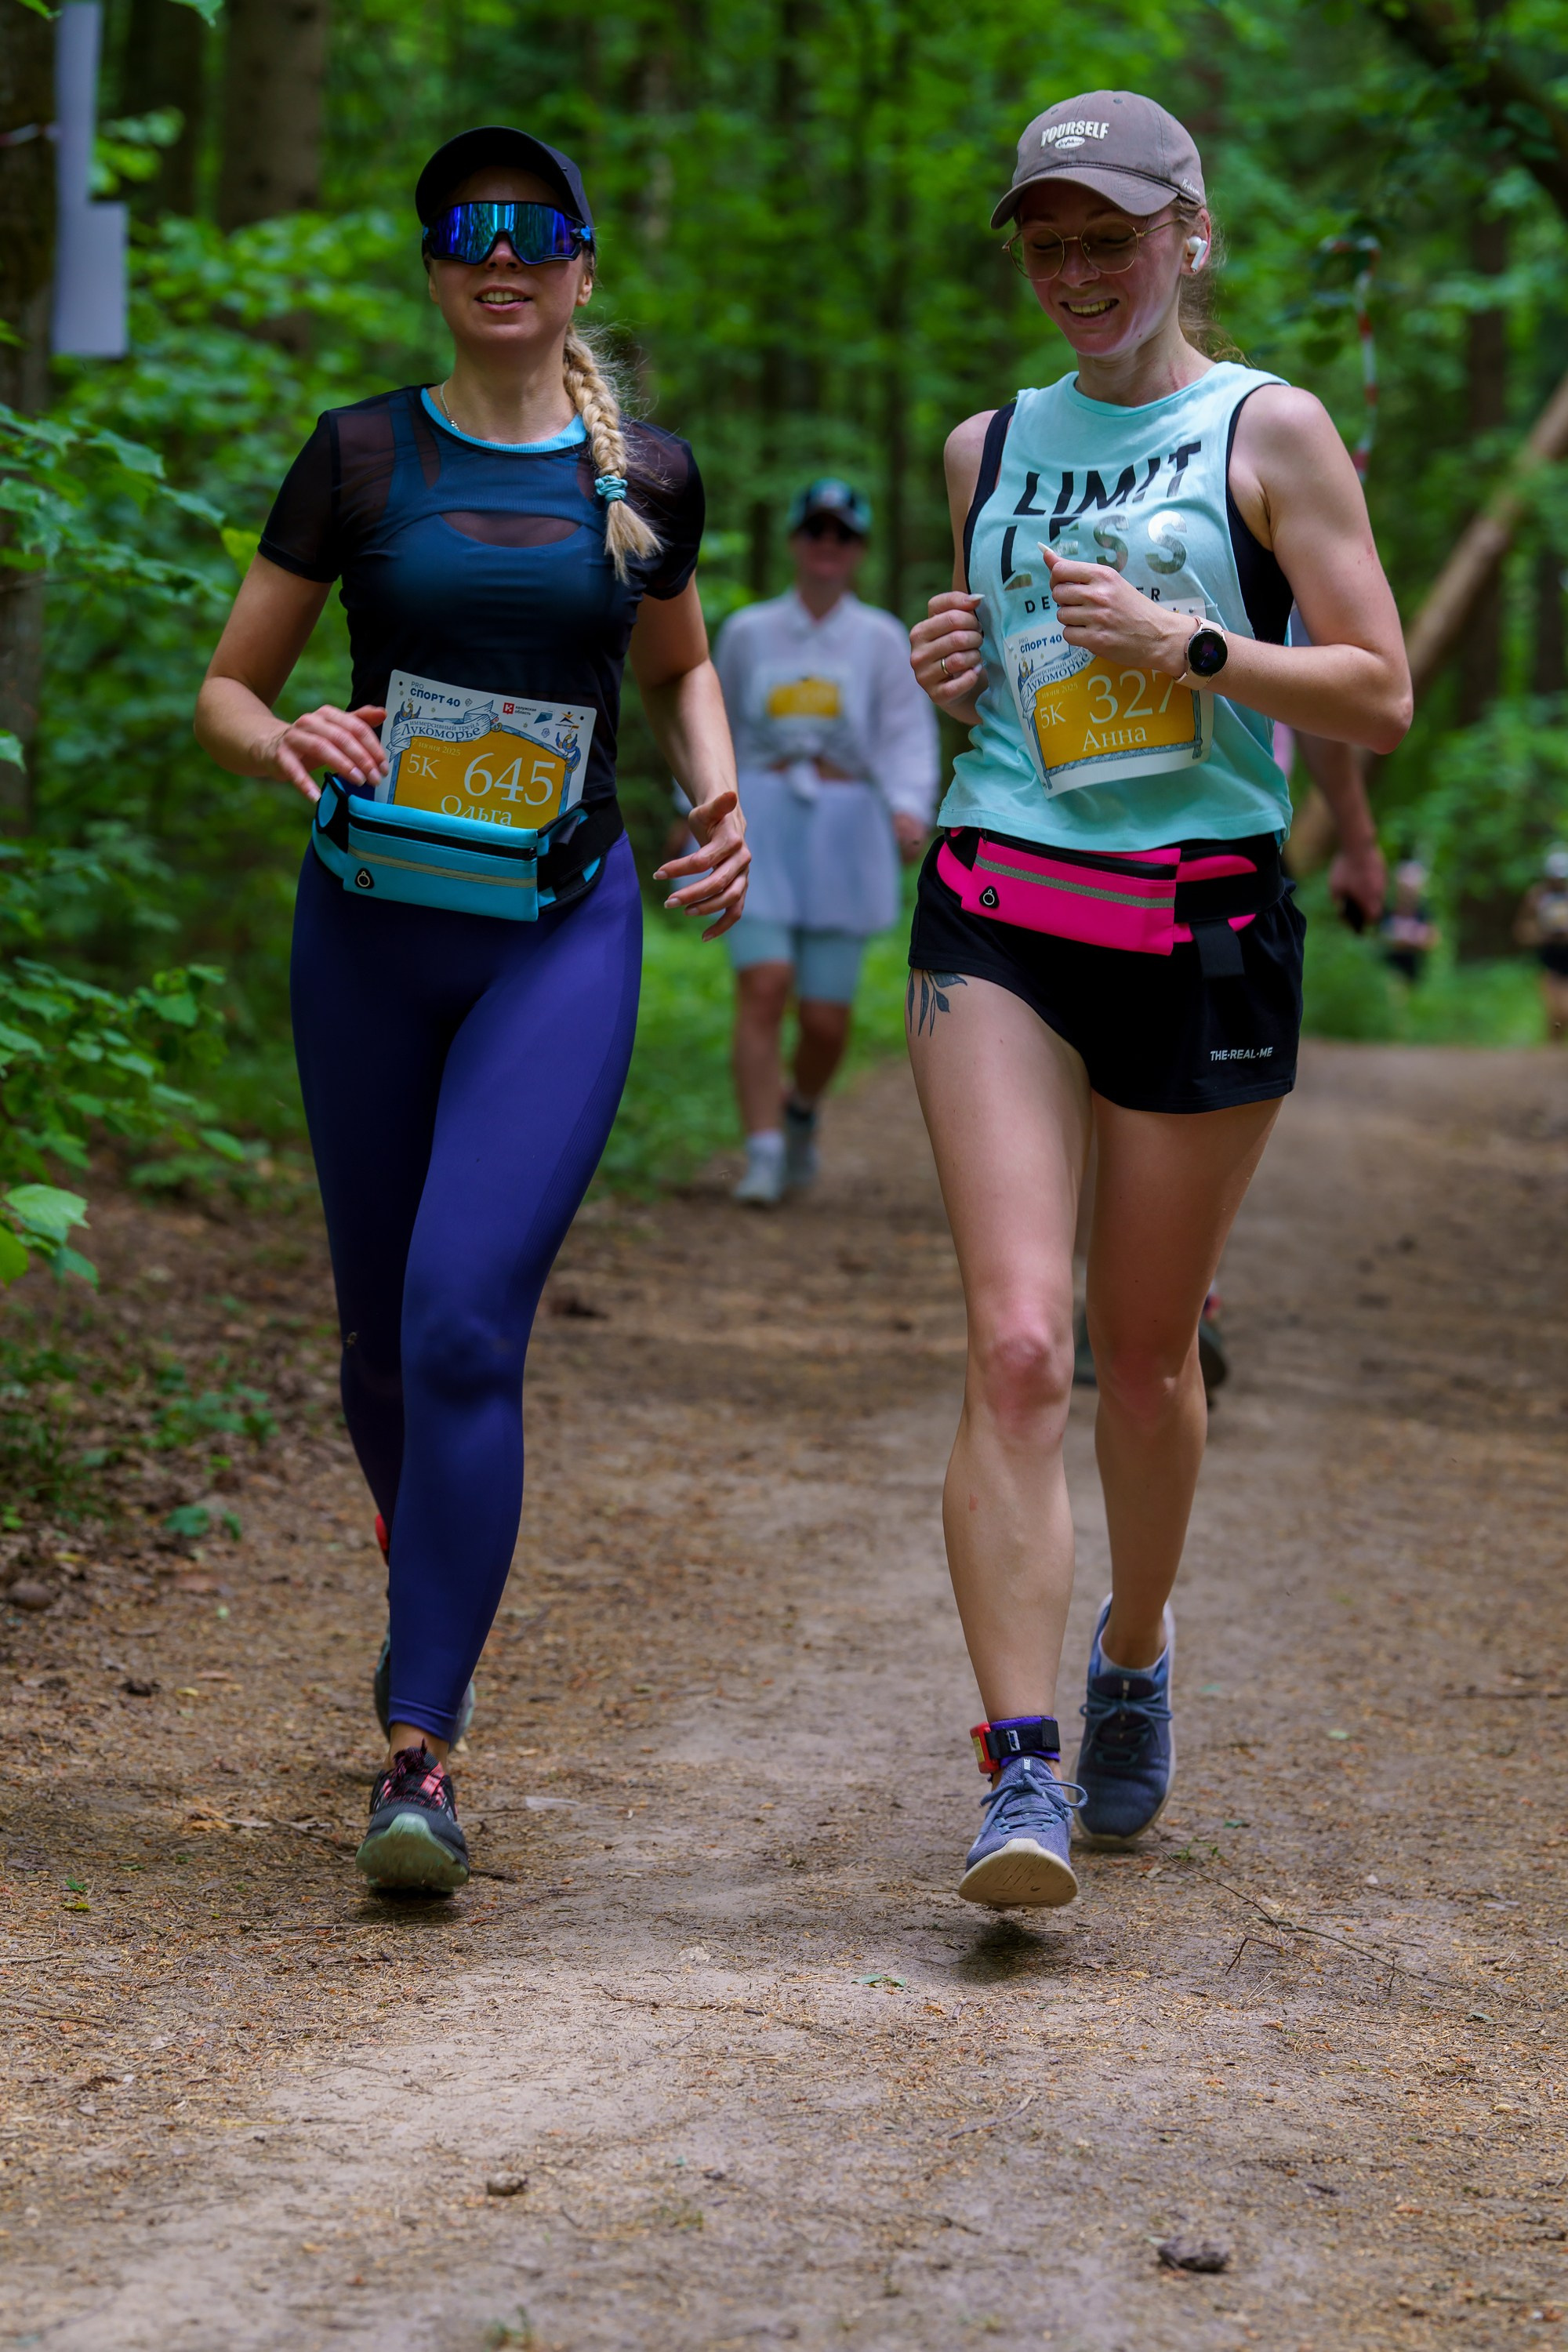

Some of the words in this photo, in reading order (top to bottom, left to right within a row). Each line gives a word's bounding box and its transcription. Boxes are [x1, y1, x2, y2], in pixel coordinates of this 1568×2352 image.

[1040, 120, 1109, 149] YOURSELF
[1013, 439, 1201, 515] LIMIT
[1000, 510, 1187, 590] LESS
[1020, 637, 1047, 654] СПОРТ
[1050, 634, 1062, 644] 40
[411, 681, 424, 690] PRO
[1026, 652, 1091, 697] Лукоморье
[410, 688, 445, 703] СПОРТ
[446, 698, 461, 707] 40
[1087, 670, 1176, 724] 327
[401, 724, 481, 742] Лукоморье
[1082, 727, 1147, 752] Анна
[441, 746, 461, 756] 2025
[463, 752, 557, 806] 645
[441, 795, 512, 826] Ольга
